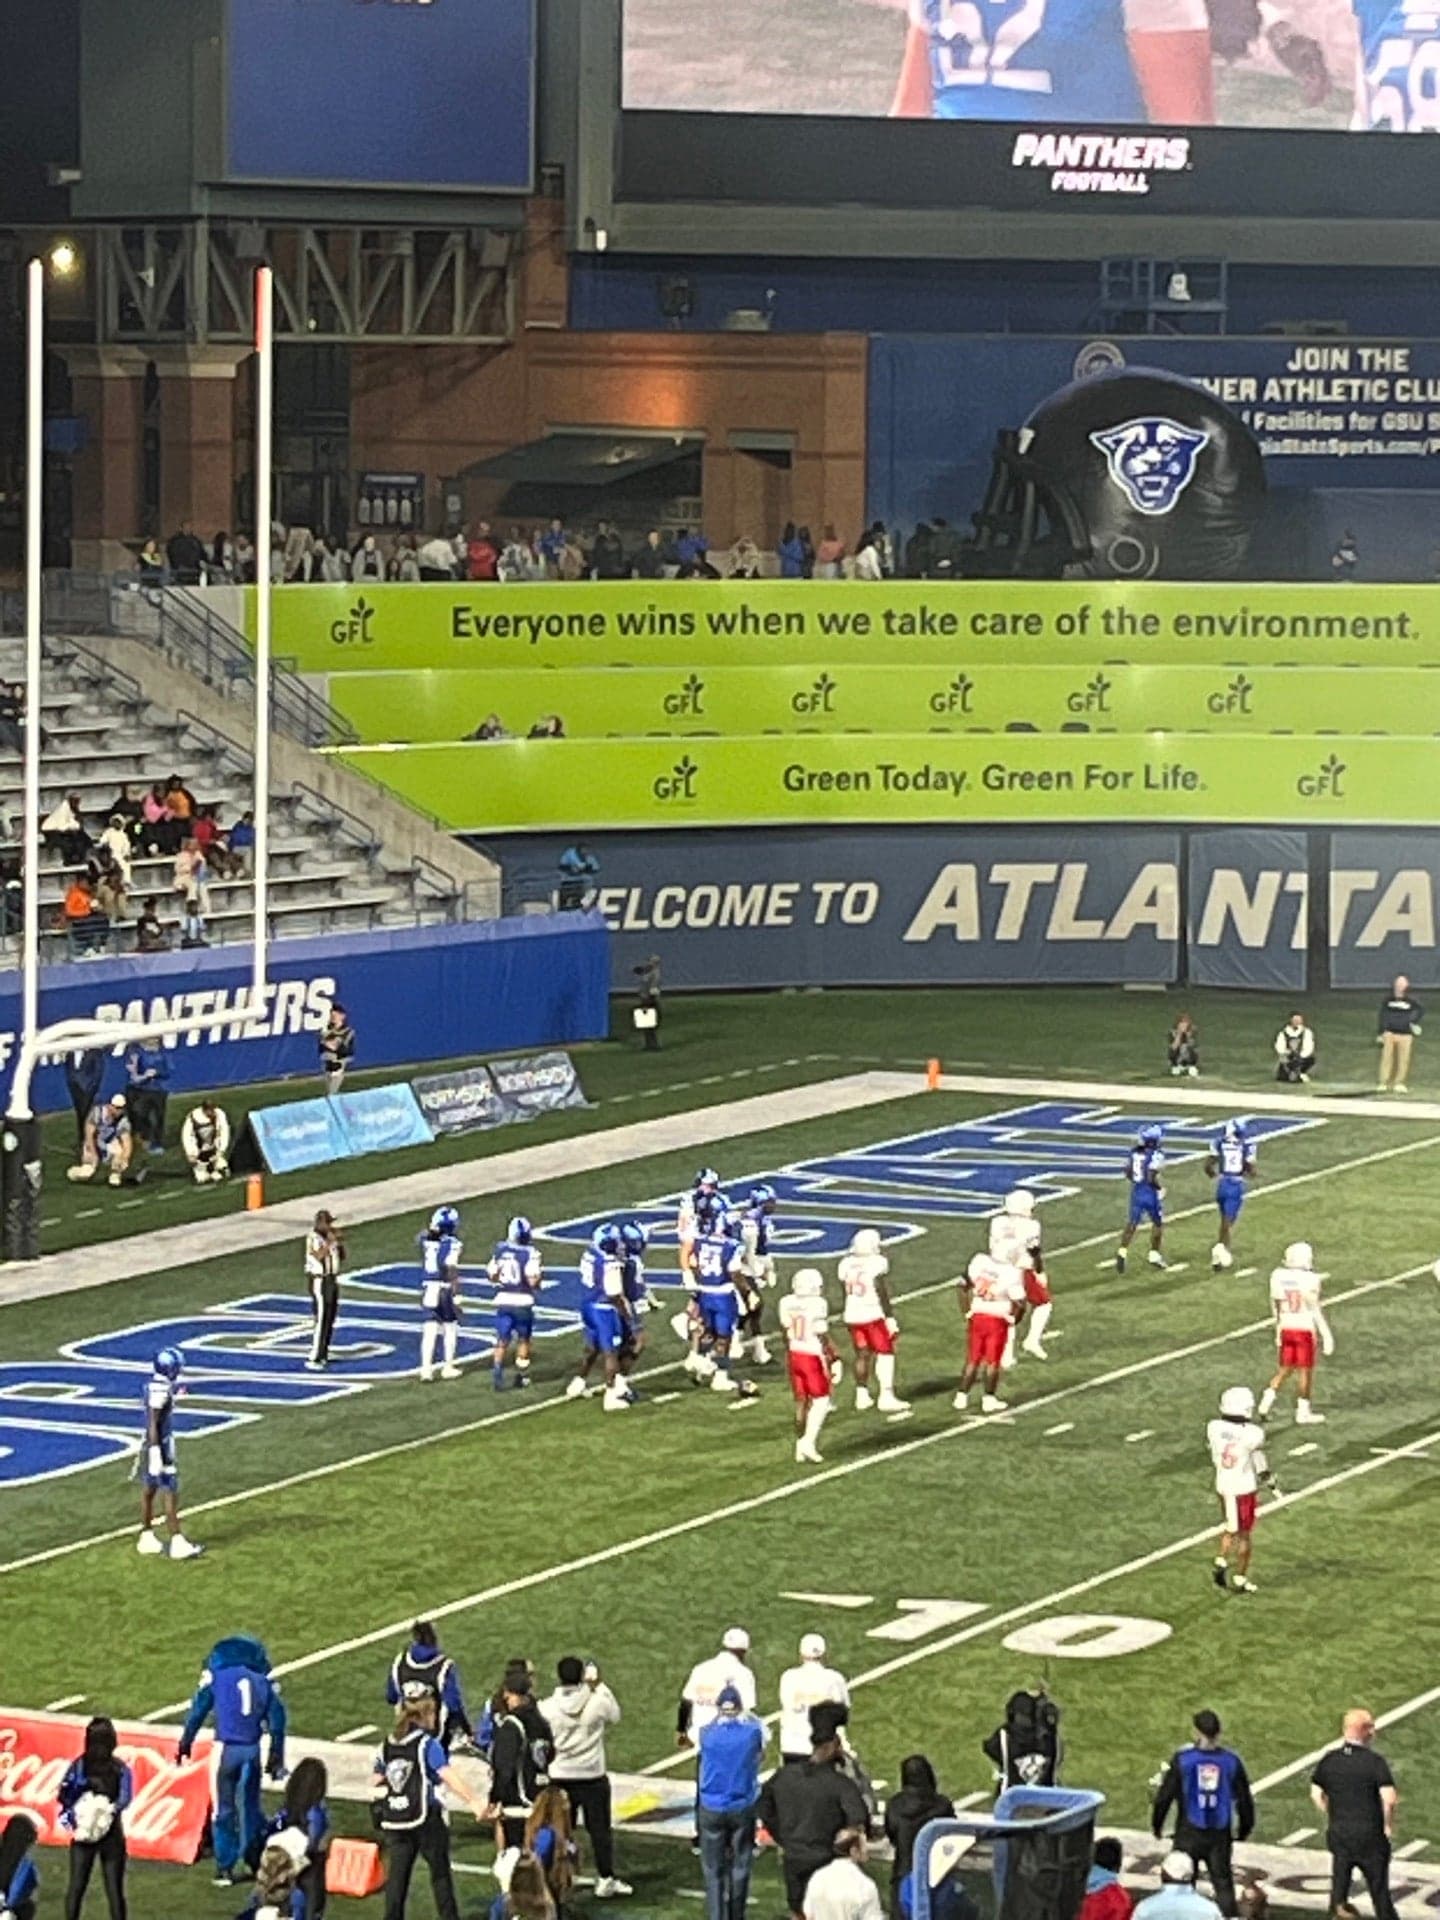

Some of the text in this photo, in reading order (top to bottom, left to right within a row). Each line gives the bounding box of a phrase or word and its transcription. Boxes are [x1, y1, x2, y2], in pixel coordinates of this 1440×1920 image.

[1012, 134, 1190, 170] PANTHERS
[1052, 171, 1149, 192] FOOTBALL
[1287, 348, 1409, 372] JOIN THE
[1191, 377, 1440, 402] HER ATHLETIC CLU
[1253, 411, 1344, 431] Facilities
[1349, 411, 1378, 431] for
[1381, 412, 1424, 431] GSU
[331, 604, 1420, 644] GFL Everyone wins when we take care of the environment.
[664, 681, 1253, 714] GFL GFL GFL GFL GFL
[654, 764, 699, 797] GFL
[783, 765, 870, 791] Green
[982, 764, 1073, 791] Green
[1084, 764, 1134, 790] For
[1144, 763, 1206, 791] Life.
[1297, 763, 1347, 797] GFL
[811, 882, 879, 924] TO
[902, 863, 1435, 950] ATLANTA
[235, 1677, 252, 1716] 1
